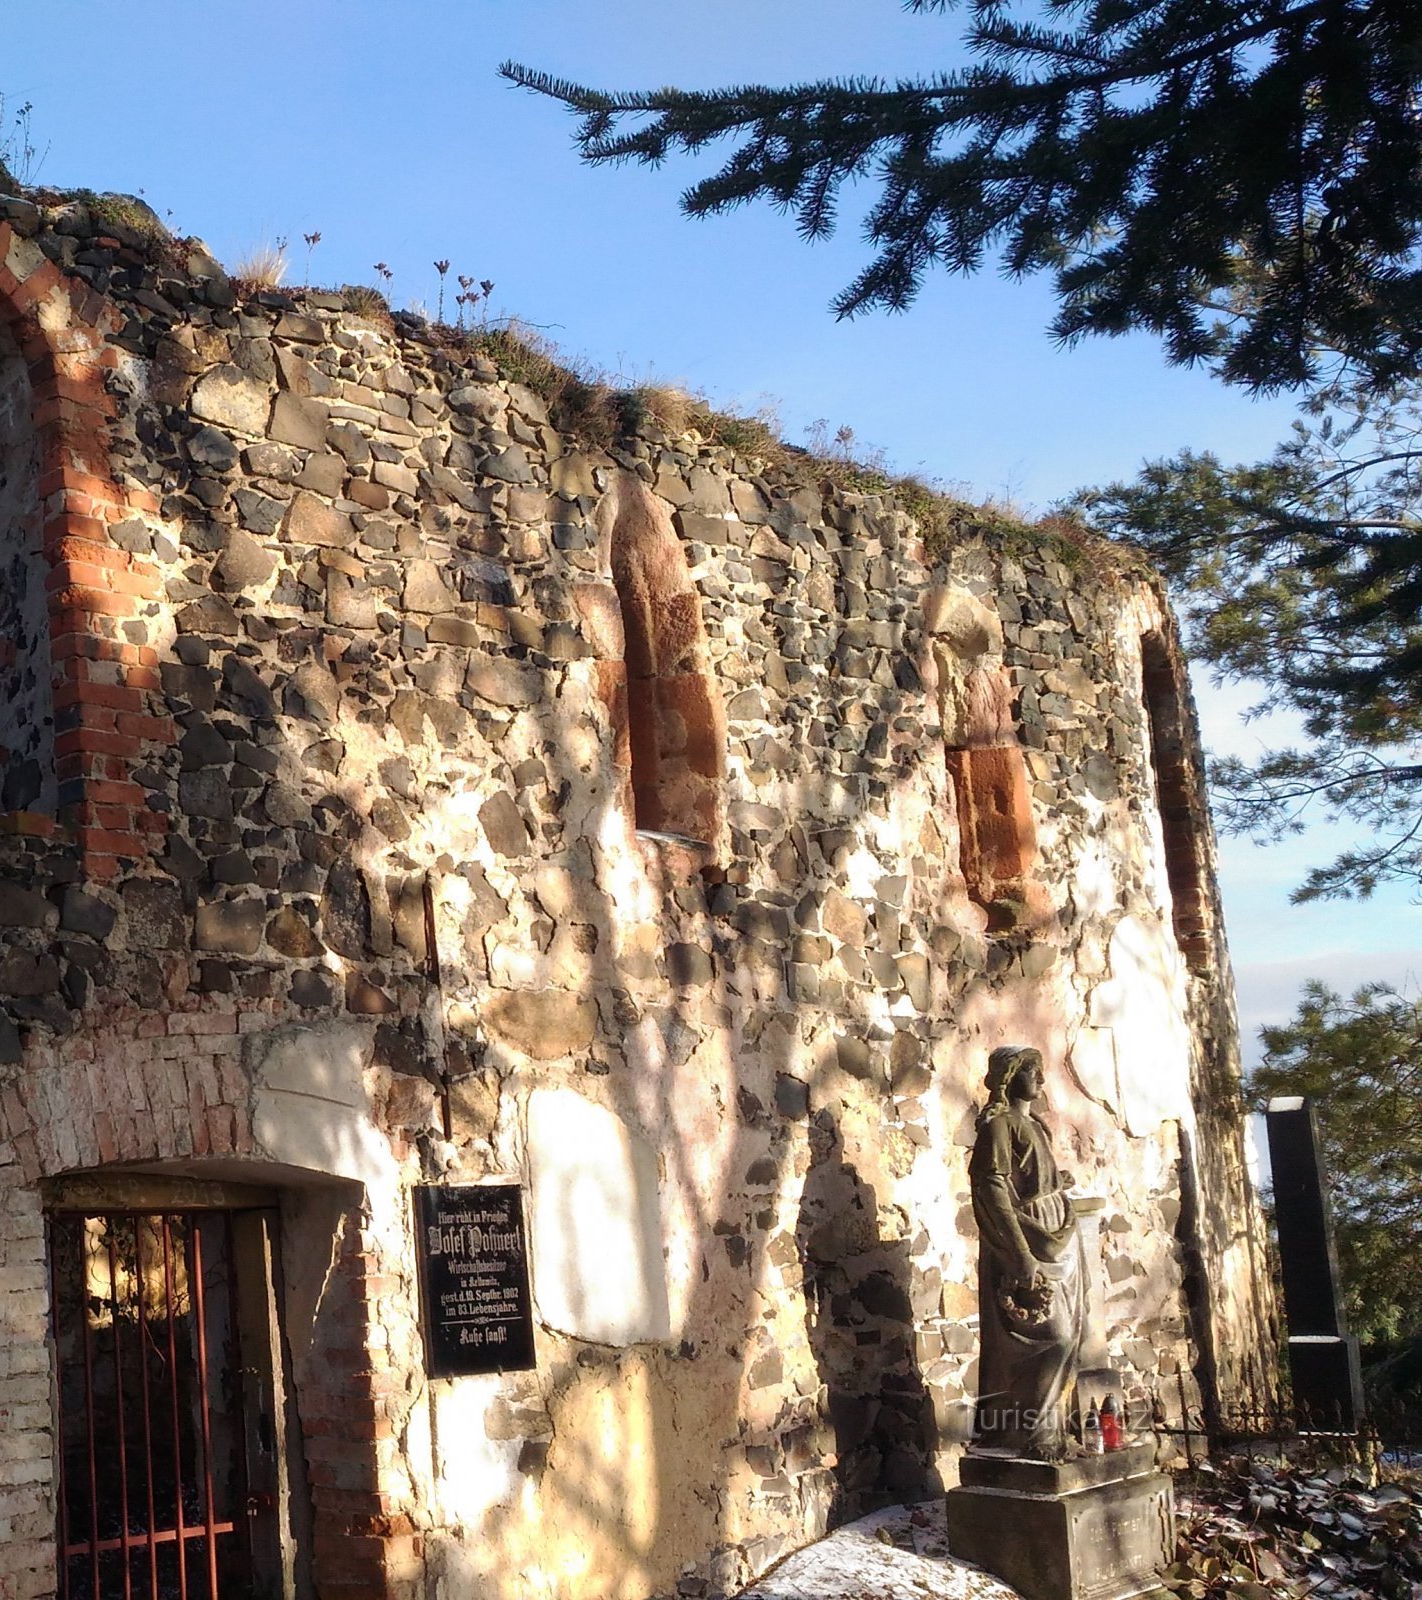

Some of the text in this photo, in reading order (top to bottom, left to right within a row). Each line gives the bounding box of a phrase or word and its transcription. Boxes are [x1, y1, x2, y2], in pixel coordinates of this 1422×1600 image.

[438, 1211, 455, 1225] Hier
[473, 1211, 481, 1223] in
[428, 1225, 465, 1258] Josef
[461, 1277, 467, 1287] in
[446, 1304, 456, 1316] im
[459, 1326, 483, 1347] Ruhe
